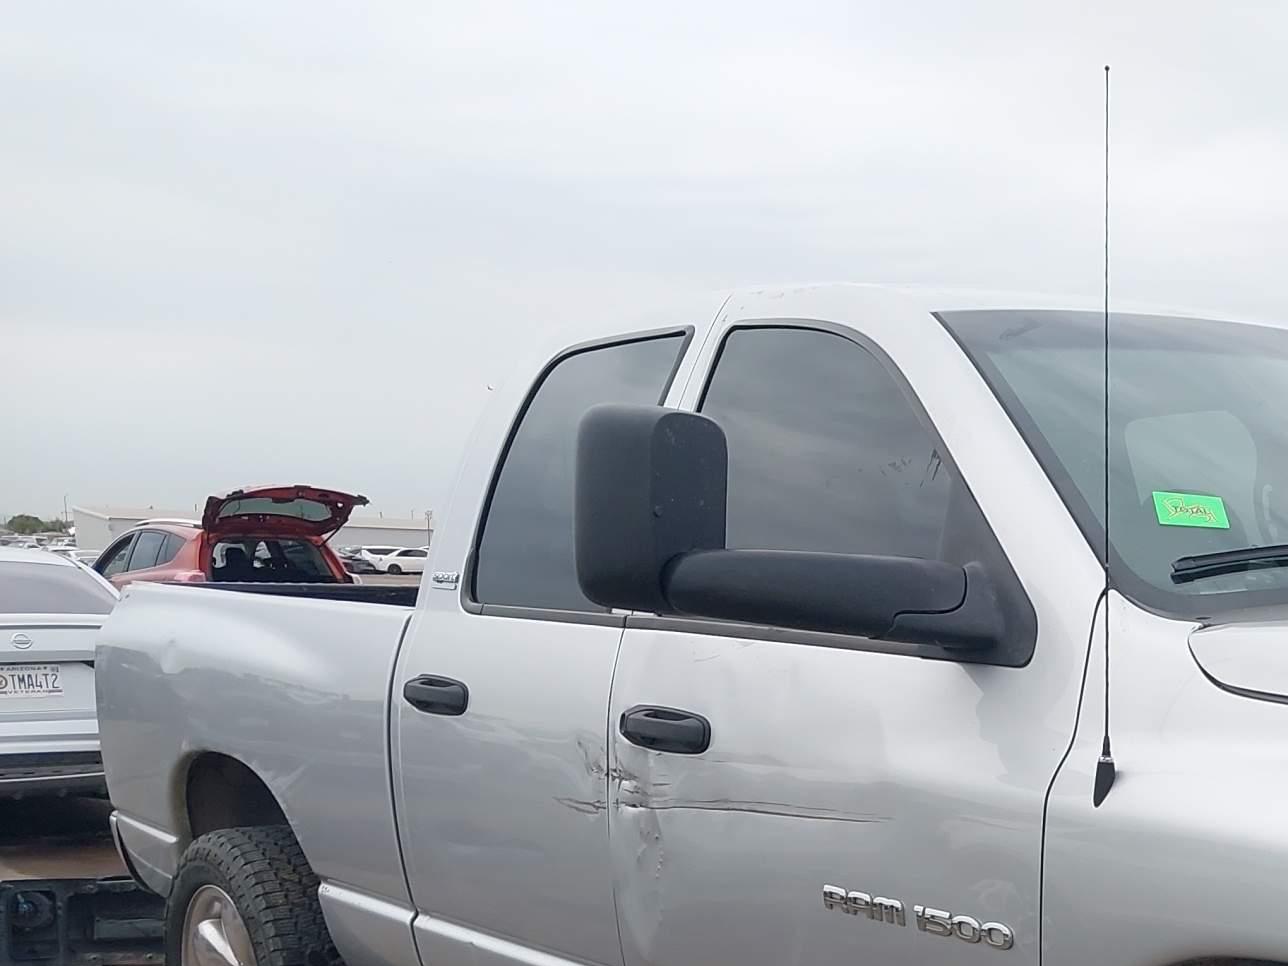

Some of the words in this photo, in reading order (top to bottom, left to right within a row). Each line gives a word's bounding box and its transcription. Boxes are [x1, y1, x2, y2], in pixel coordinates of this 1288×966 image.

[8, 673, 60, 690] TMA4T2
[823, 883, 906, 928] RAM
[913, 904, 1014, 951] 1500
